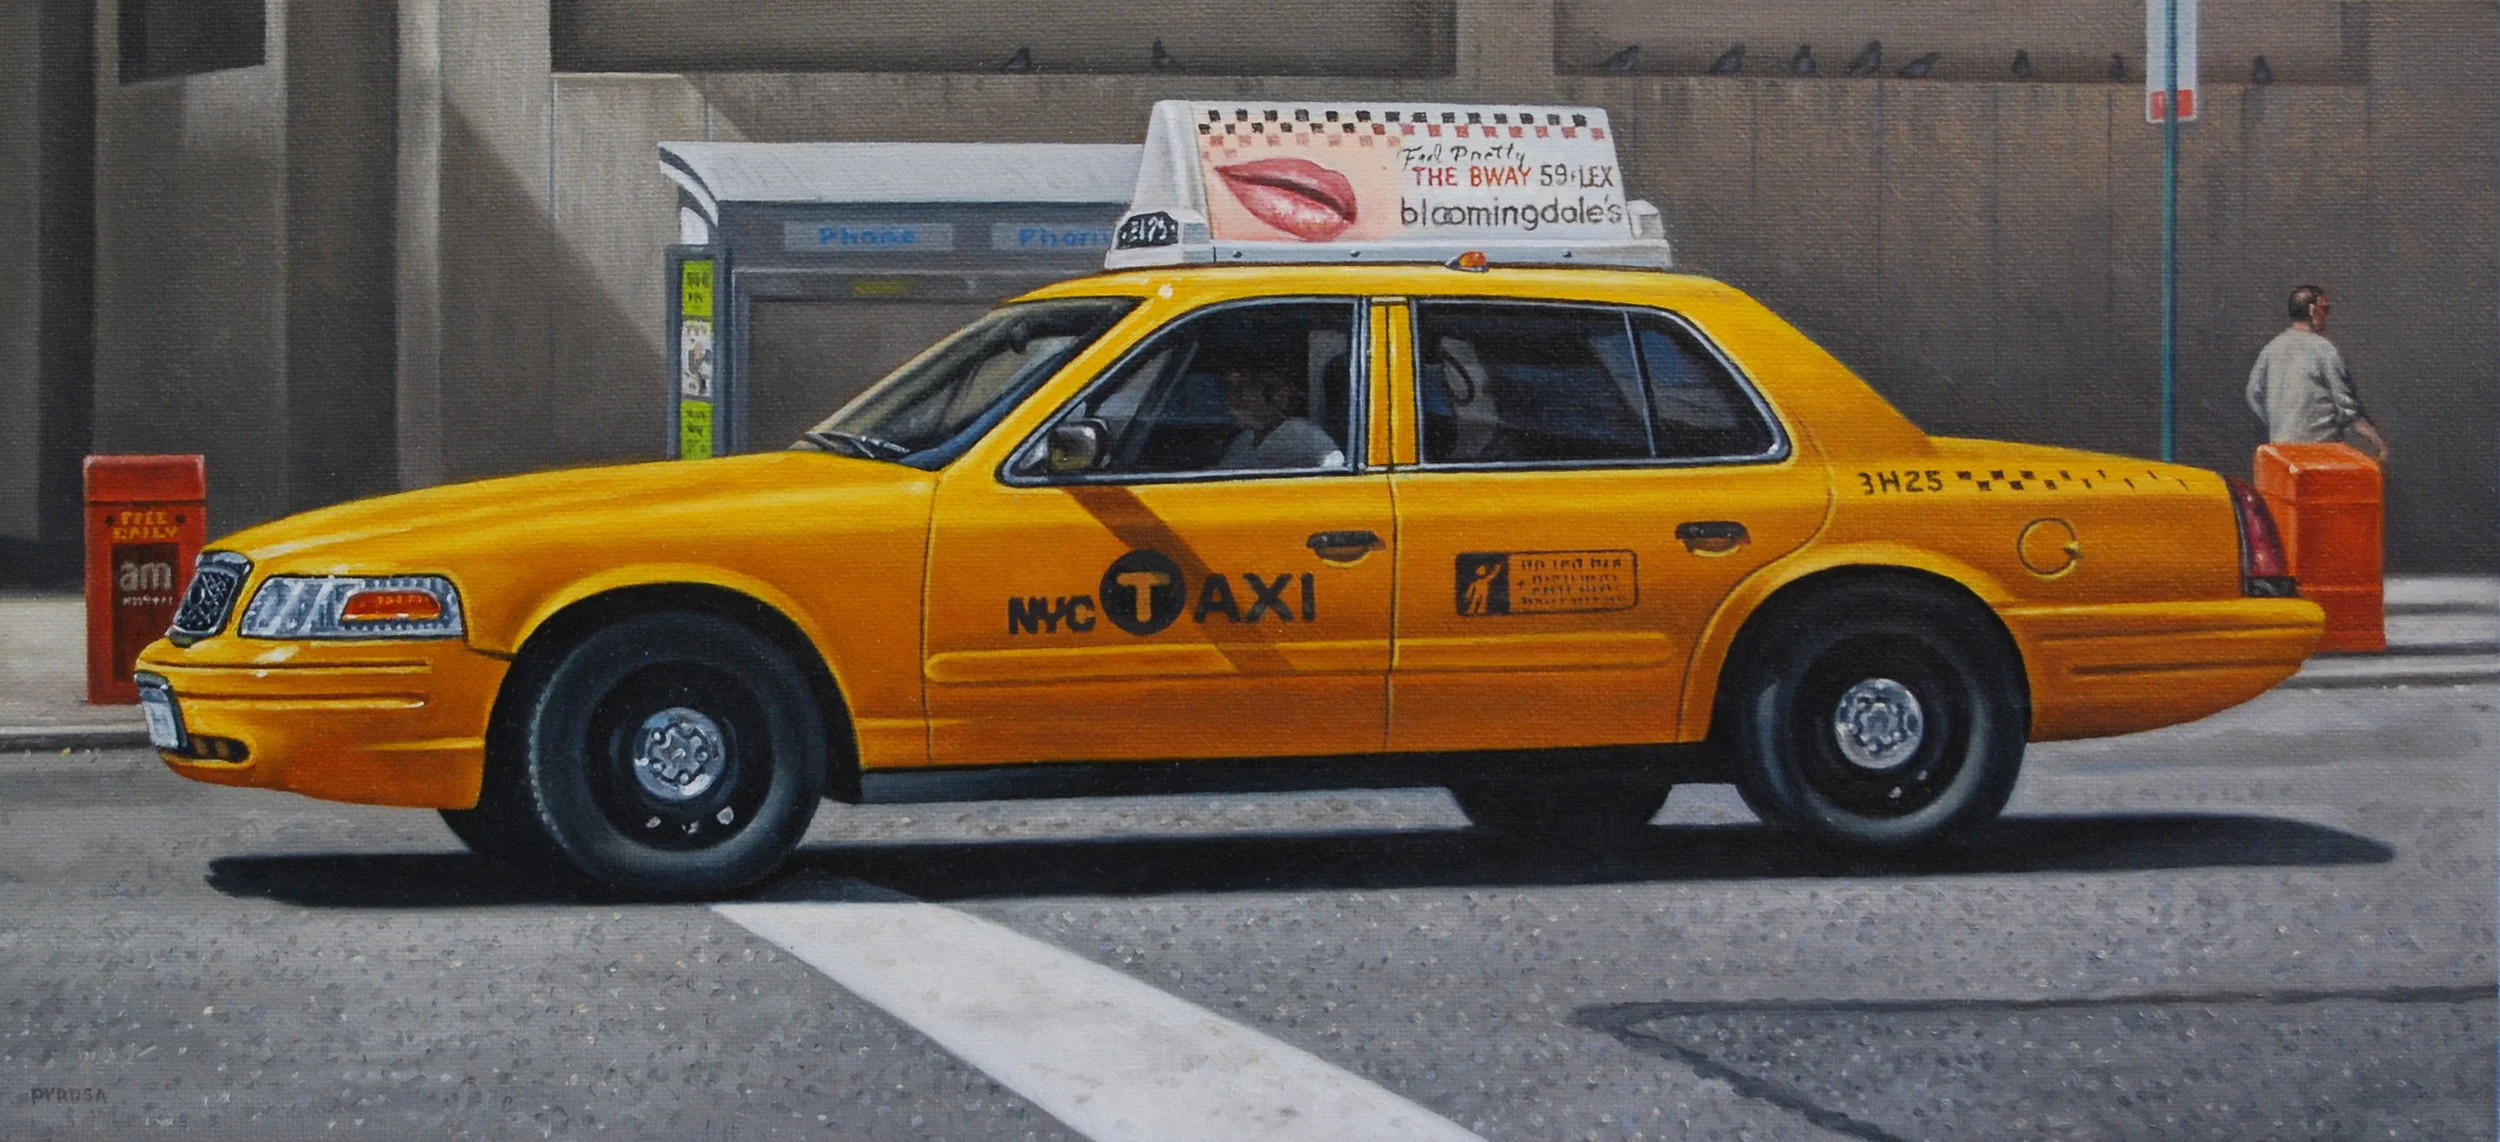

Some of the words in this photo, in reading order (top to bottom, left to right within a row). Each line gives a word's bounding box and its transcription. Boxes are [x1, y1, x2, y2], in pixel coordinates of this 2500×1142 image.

[1412, 166, 1457, 186] THE
[1470, 166, 1531, 187] BWAY
[1401, 196, 1622, 231] bloomingdale's
[819, 227, 918, 246] Phone
[1858, 470, 1943, 495] 3H25
[120, 562, 172, 592] am
[1008, 594, 1096, 635] NYC
